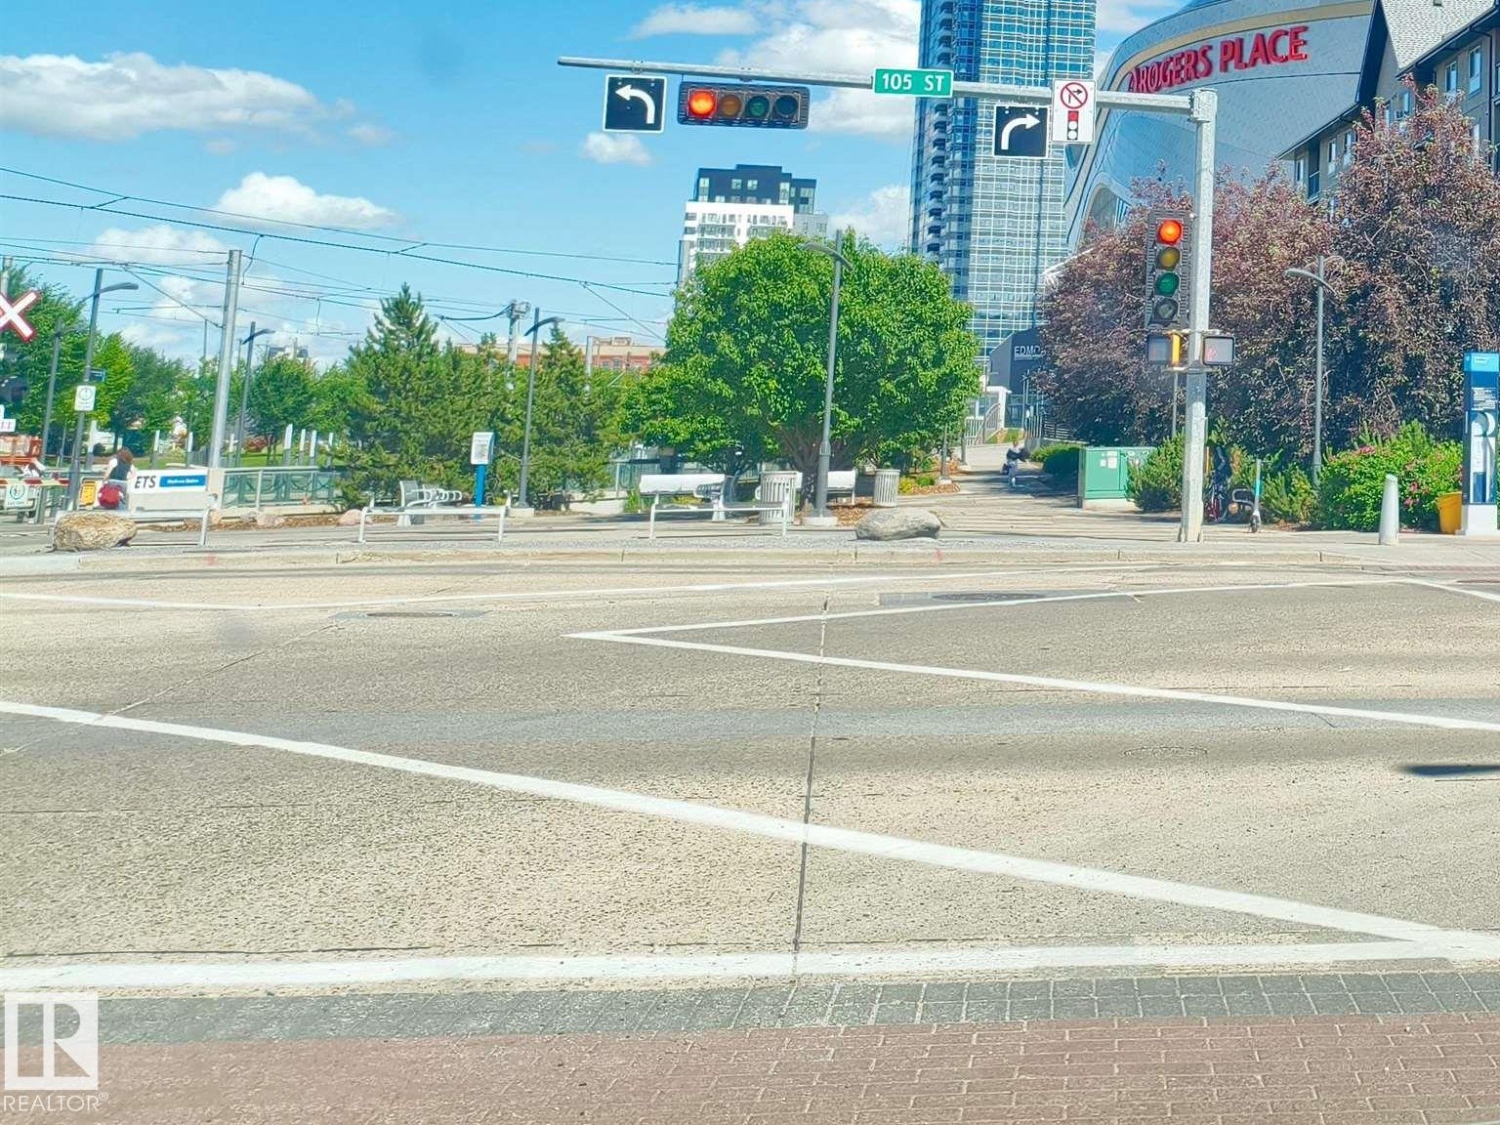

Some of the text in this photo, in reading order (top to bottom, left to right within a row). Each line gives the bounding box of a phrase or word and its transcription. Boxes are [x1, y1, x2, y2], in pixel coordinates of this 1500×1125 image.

[1139, 26, 1309, 93] ROGERS PLACE
[882, 73, 944, 92] 105 ST
[134, 475, 156, 489] ETS
